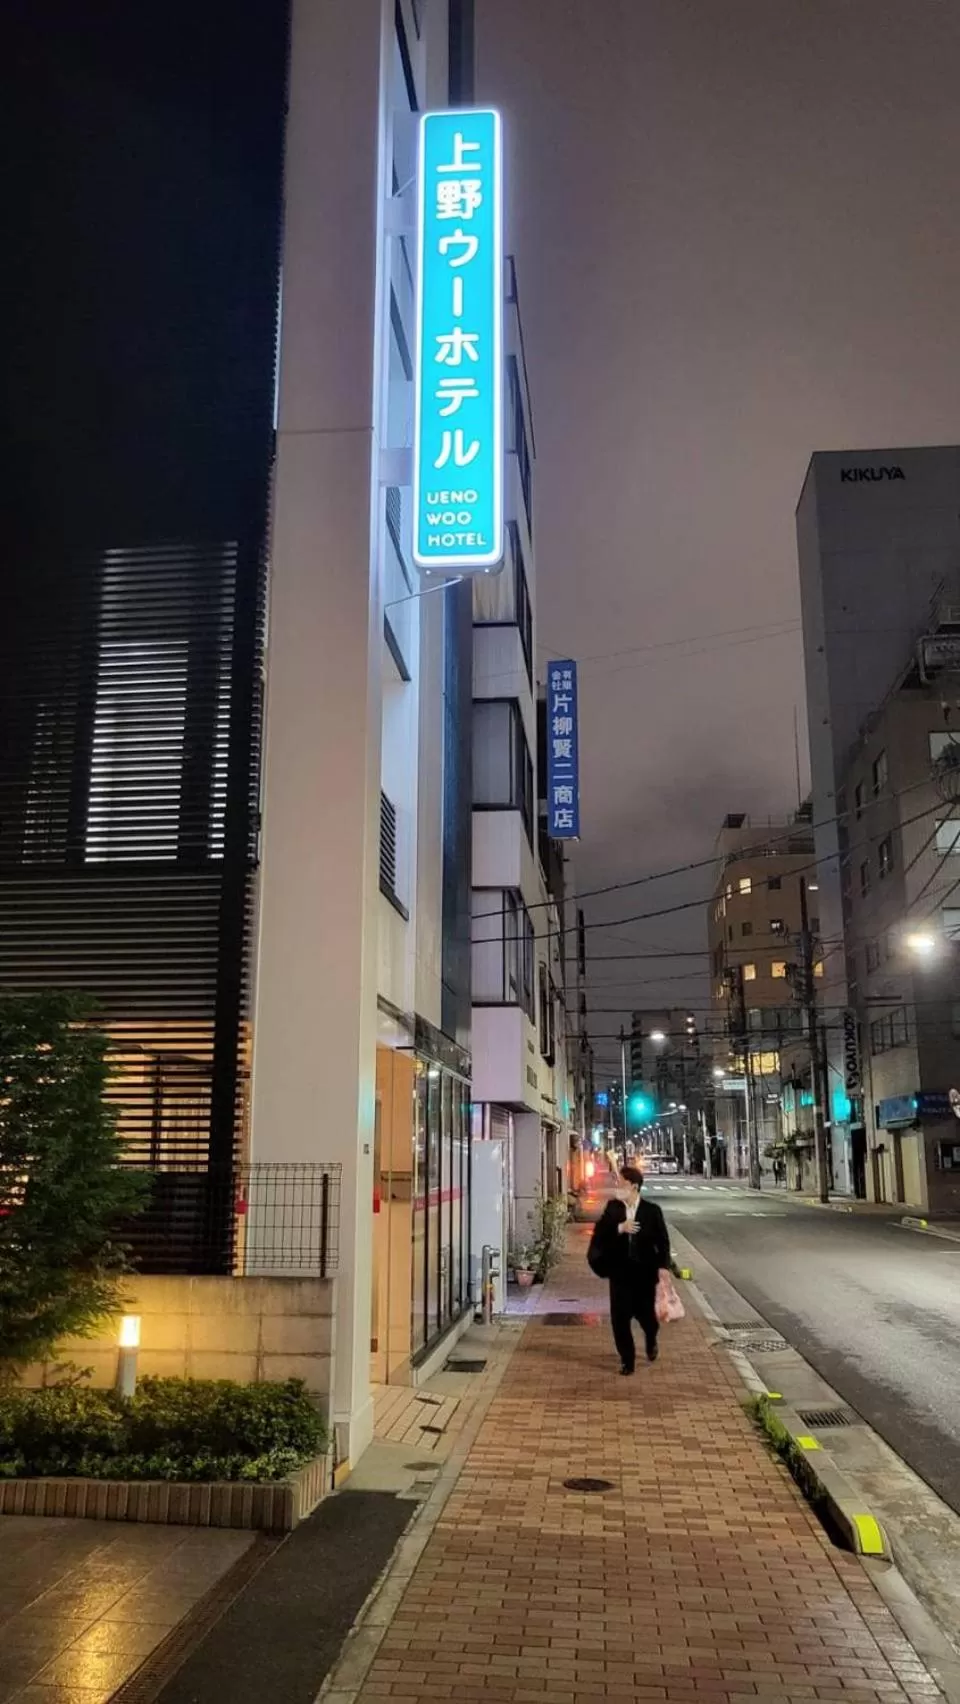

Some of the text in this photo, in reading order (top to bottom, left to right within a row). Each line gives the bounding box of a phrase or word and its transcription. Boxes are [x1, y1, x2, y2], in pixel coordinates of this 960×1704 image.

[434, 131, 482, 471] 上野ウーホテル
[840, 466, 905, 482] KIKUYA
[426, 489, 478, 505] UENO
[426, 511, 472, 526] WOO
[427, 532, 486, 547] HOTEL
[553, 693, 574, 828] 片柳賢二商店
